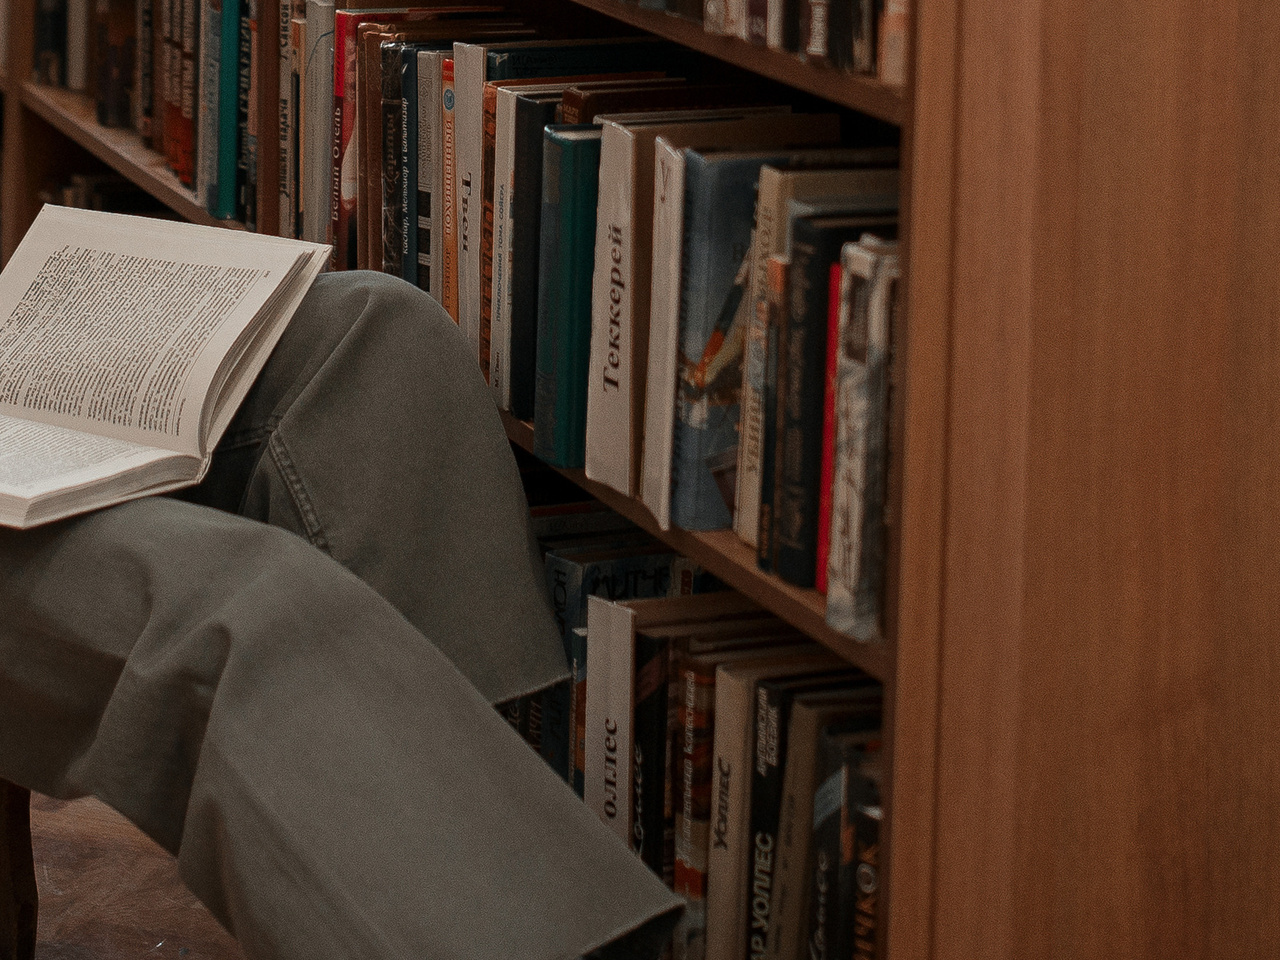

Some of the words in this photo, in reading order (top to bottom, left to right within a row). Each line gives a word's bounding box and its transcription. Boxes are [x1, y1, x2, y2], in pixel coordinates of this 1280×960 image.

[333, 107, 341, 160] Отель
[332, 166, 340, 221] Белый
[443, 119, 453, 237] ПОХИЩЕННЫЙ
[461, 172, 472, 252] Твен
[497, 184, 506, 221] СОЙЕРА
[496, 223, 505, 249] ТОМА
[495, 252, 504, 322] ПРИКЛЮЧЕНИЯ
[601, 223, 625, 393] Теккерей
[602, 717, 618, 820] оллес
[751, 831, 774, 932] УОЛЛЕС
